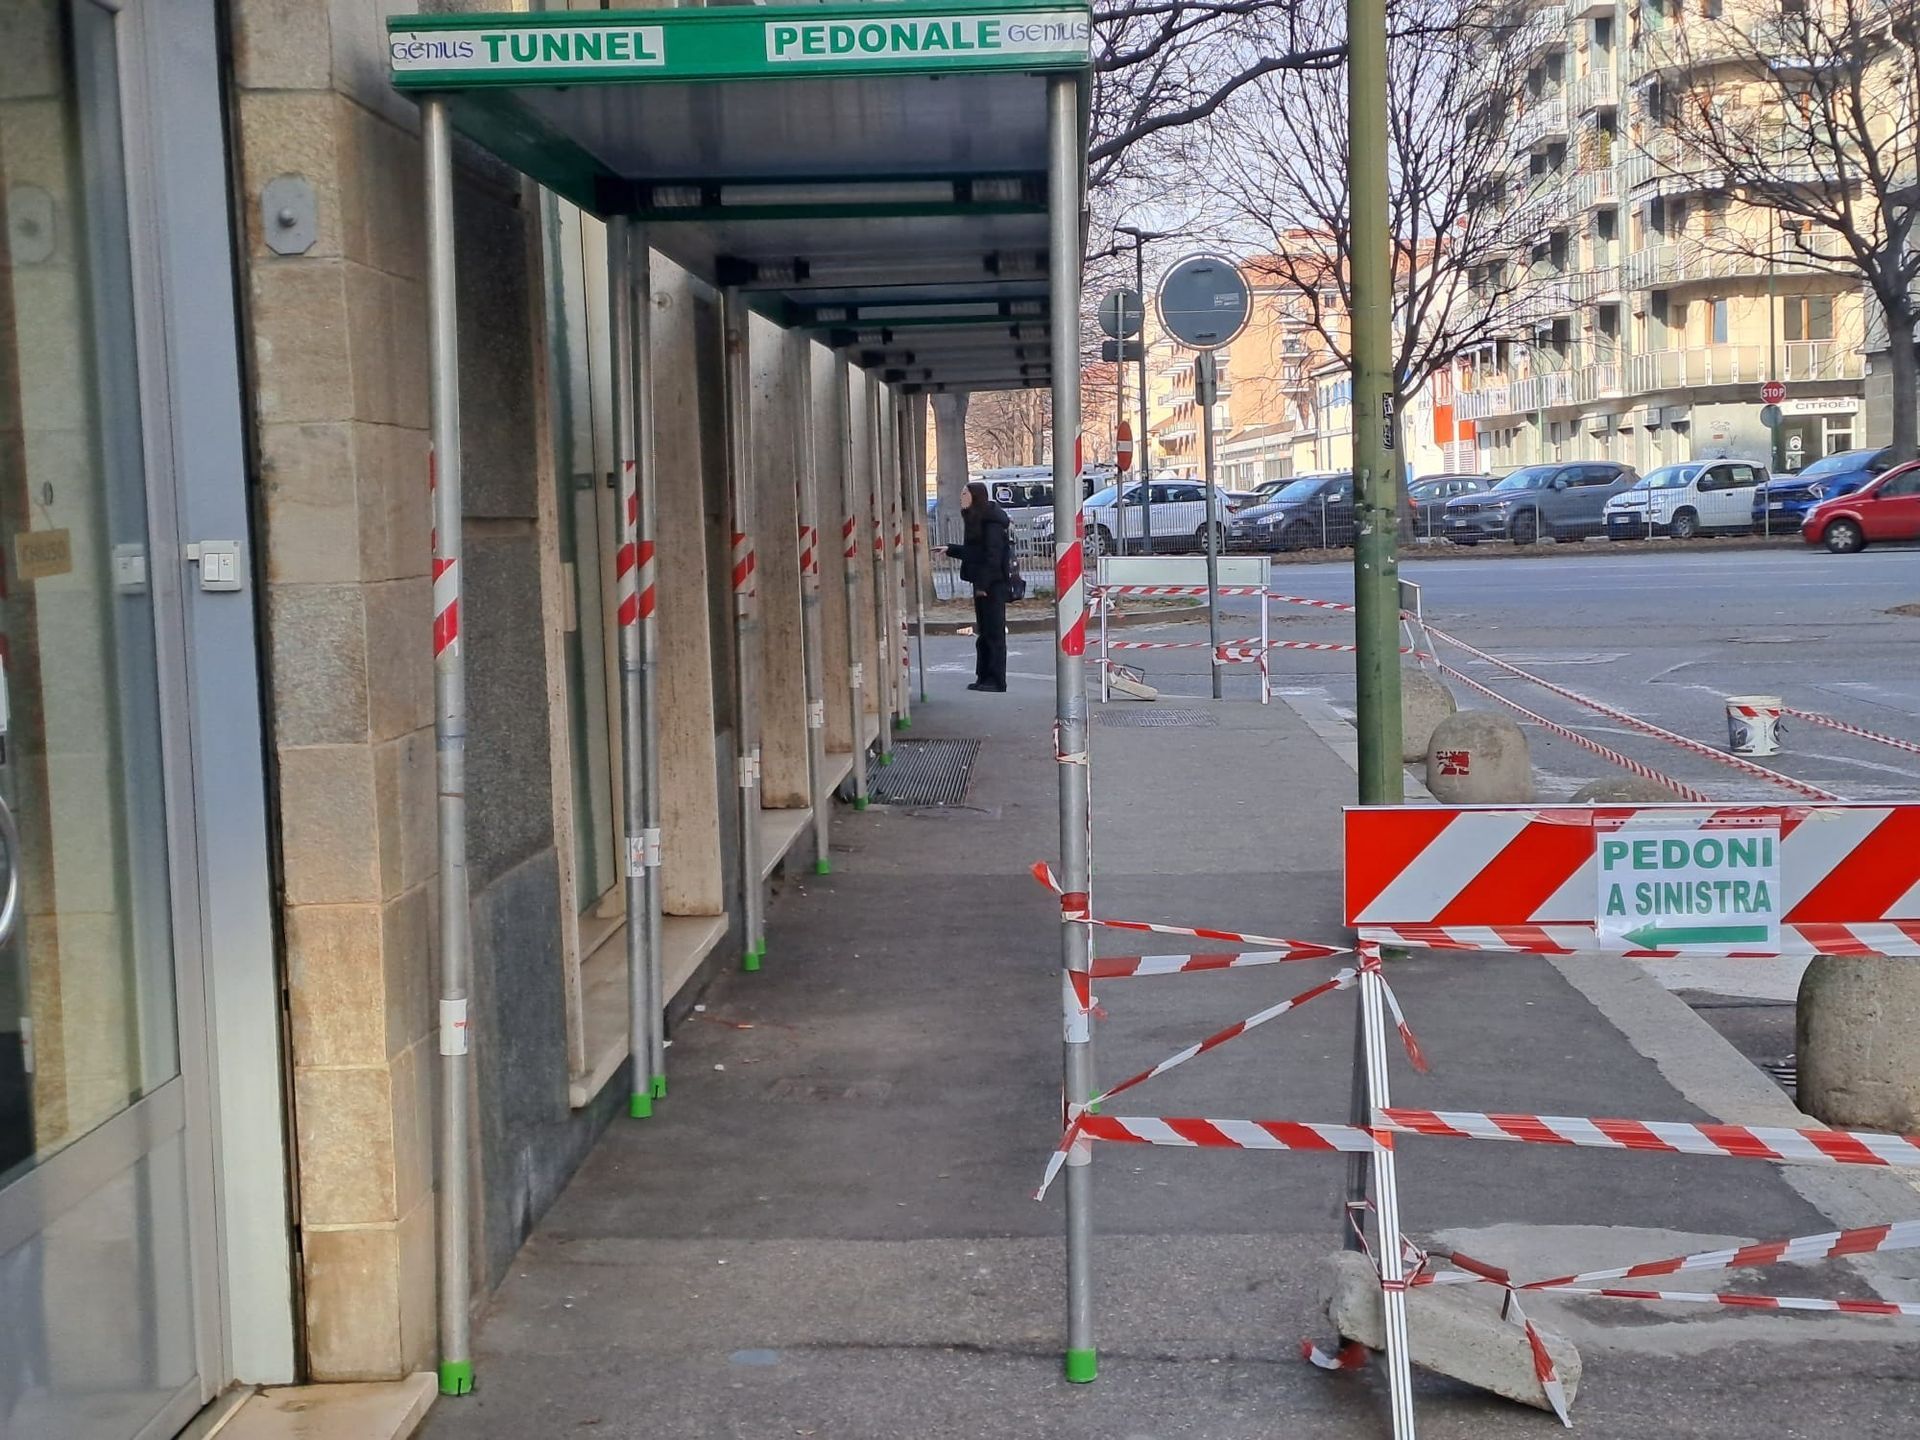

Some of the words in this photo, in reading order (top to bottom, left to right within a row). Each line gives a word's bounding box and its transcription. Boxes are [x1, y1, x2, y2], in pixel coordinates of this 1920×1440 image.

[481, 32, 657, 63] TUNNEL
[774, 20, 1002, 56] PEDONALE
[1762, 388, 1785, 398] STOP
[1602, 837, 1773, 871] PEDONI
[1606, 882, 1627, 916] A
[1635, 879, 1772, 916] SINISTRA
